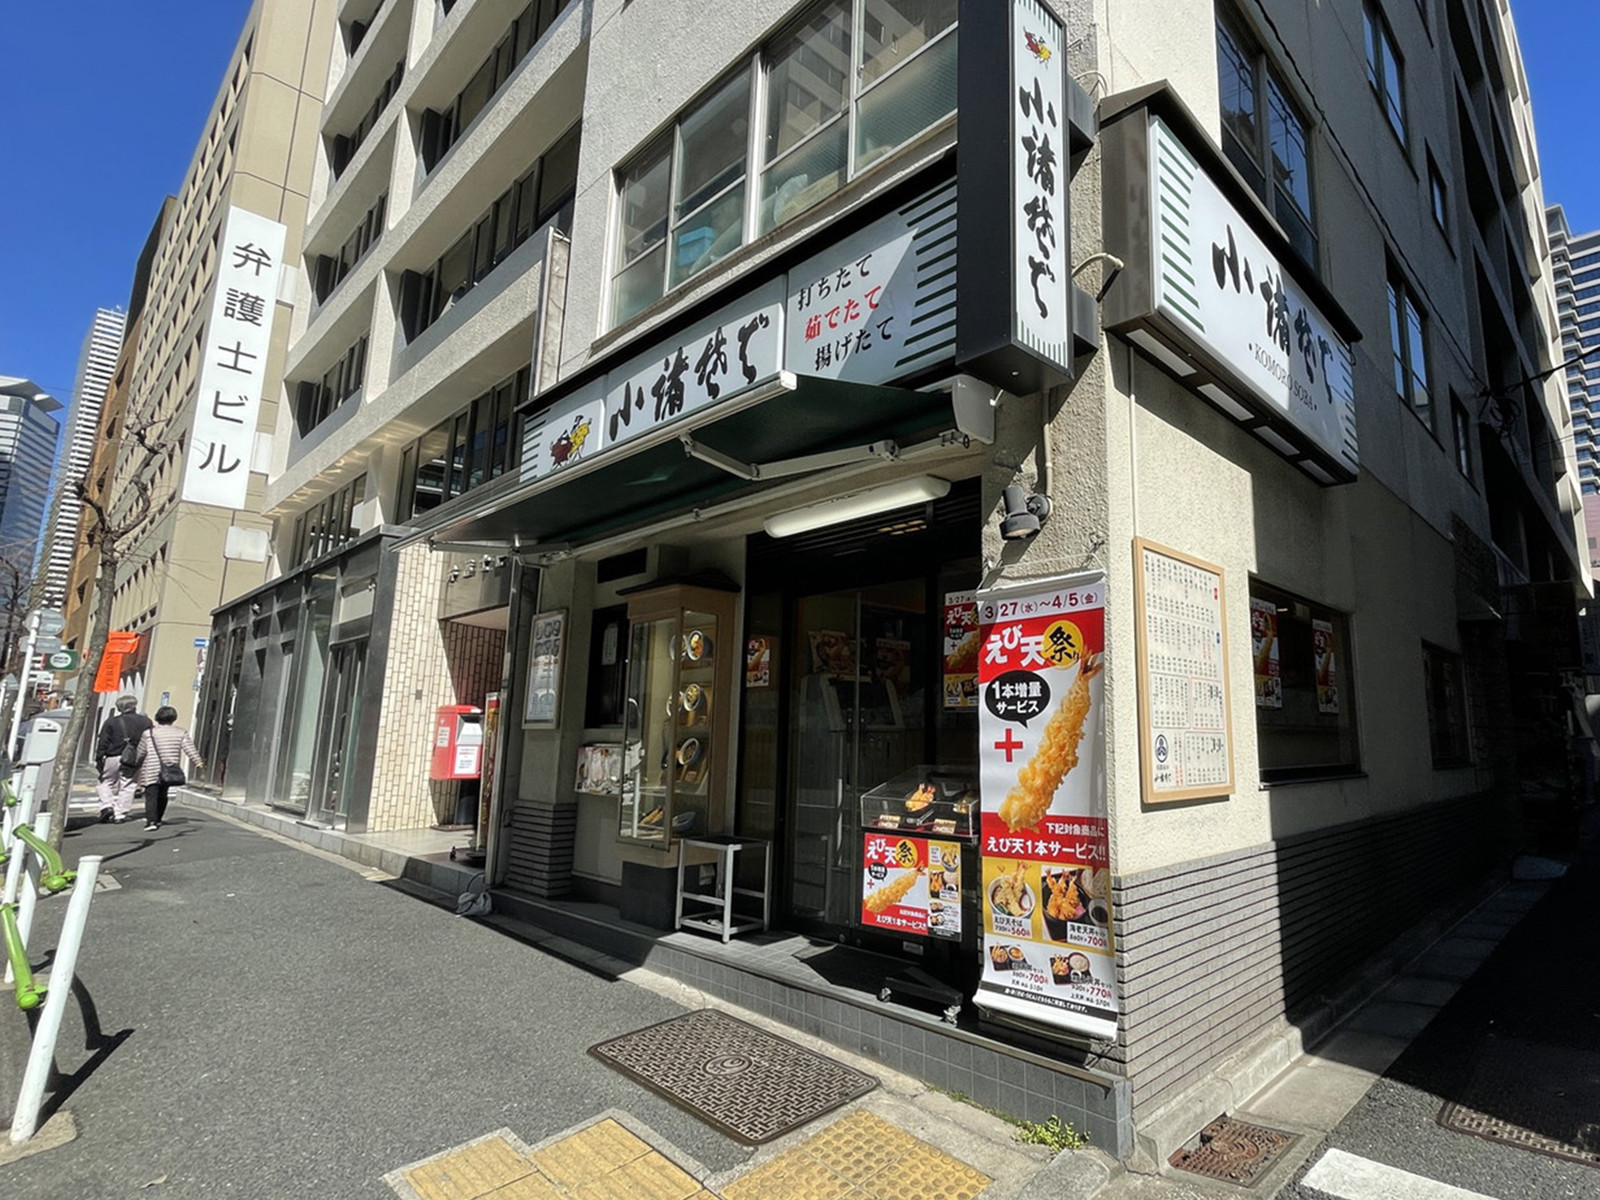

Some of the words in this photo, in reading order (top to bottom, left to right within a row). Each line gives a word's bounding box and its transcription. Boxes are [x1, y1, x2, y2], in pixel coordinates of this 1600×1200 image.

[797, 253, 873, 312] 打ちたて
[803, 284, 882, 343] 茹でたて
[198, 242, 273, 475] 弁護士ビル
[814, 315, 894, 372] 揚げたて
[1254, 342, 1293, 391] KOMORO
[991, 680, 1042, 700] 1本増量
[995, 700, 1040, 715] サービス
[1045, 821, 1106, 837] 下記対象商品に
